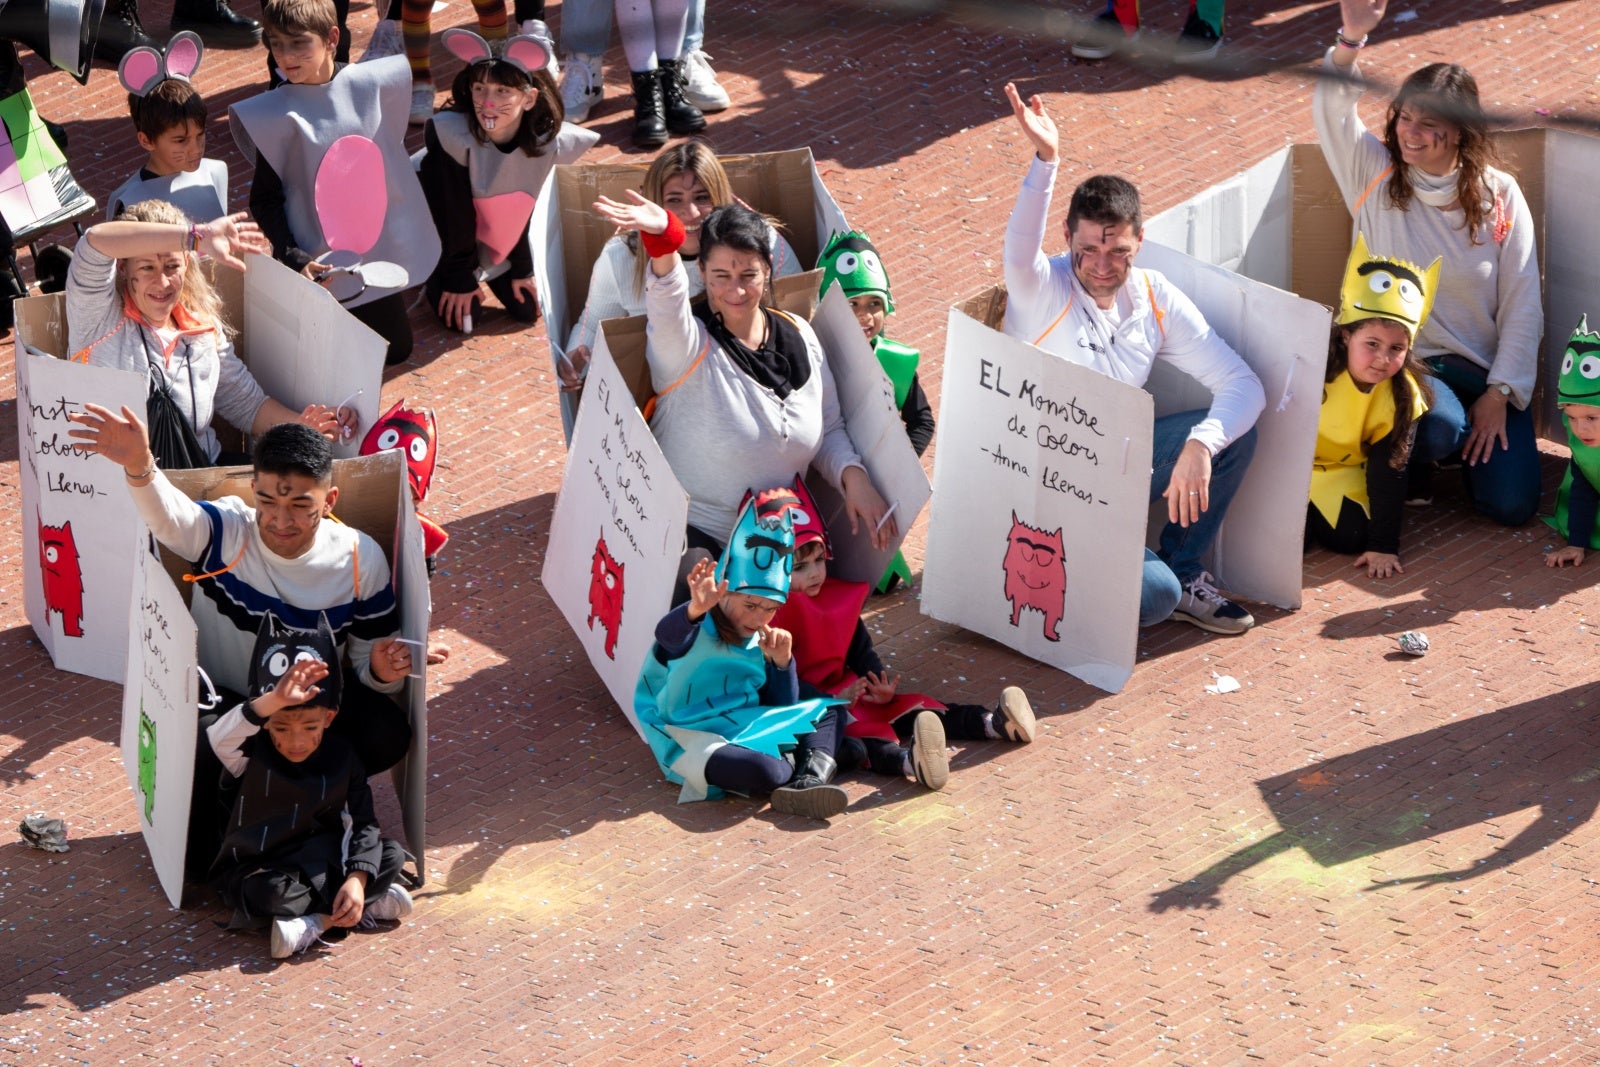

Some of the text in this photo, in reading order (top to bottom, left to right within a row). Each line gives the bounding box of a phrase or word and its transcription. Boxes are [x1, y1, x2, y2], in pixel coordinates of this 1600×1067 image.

[1101, 224, 1116, 244] F
[979, 358, 1105, 437] EL Monstre
[600, 433, 612, 461] de
[614, 412, 653, 492] Monstre
[1007, 414, 1098, 466] de Colors
